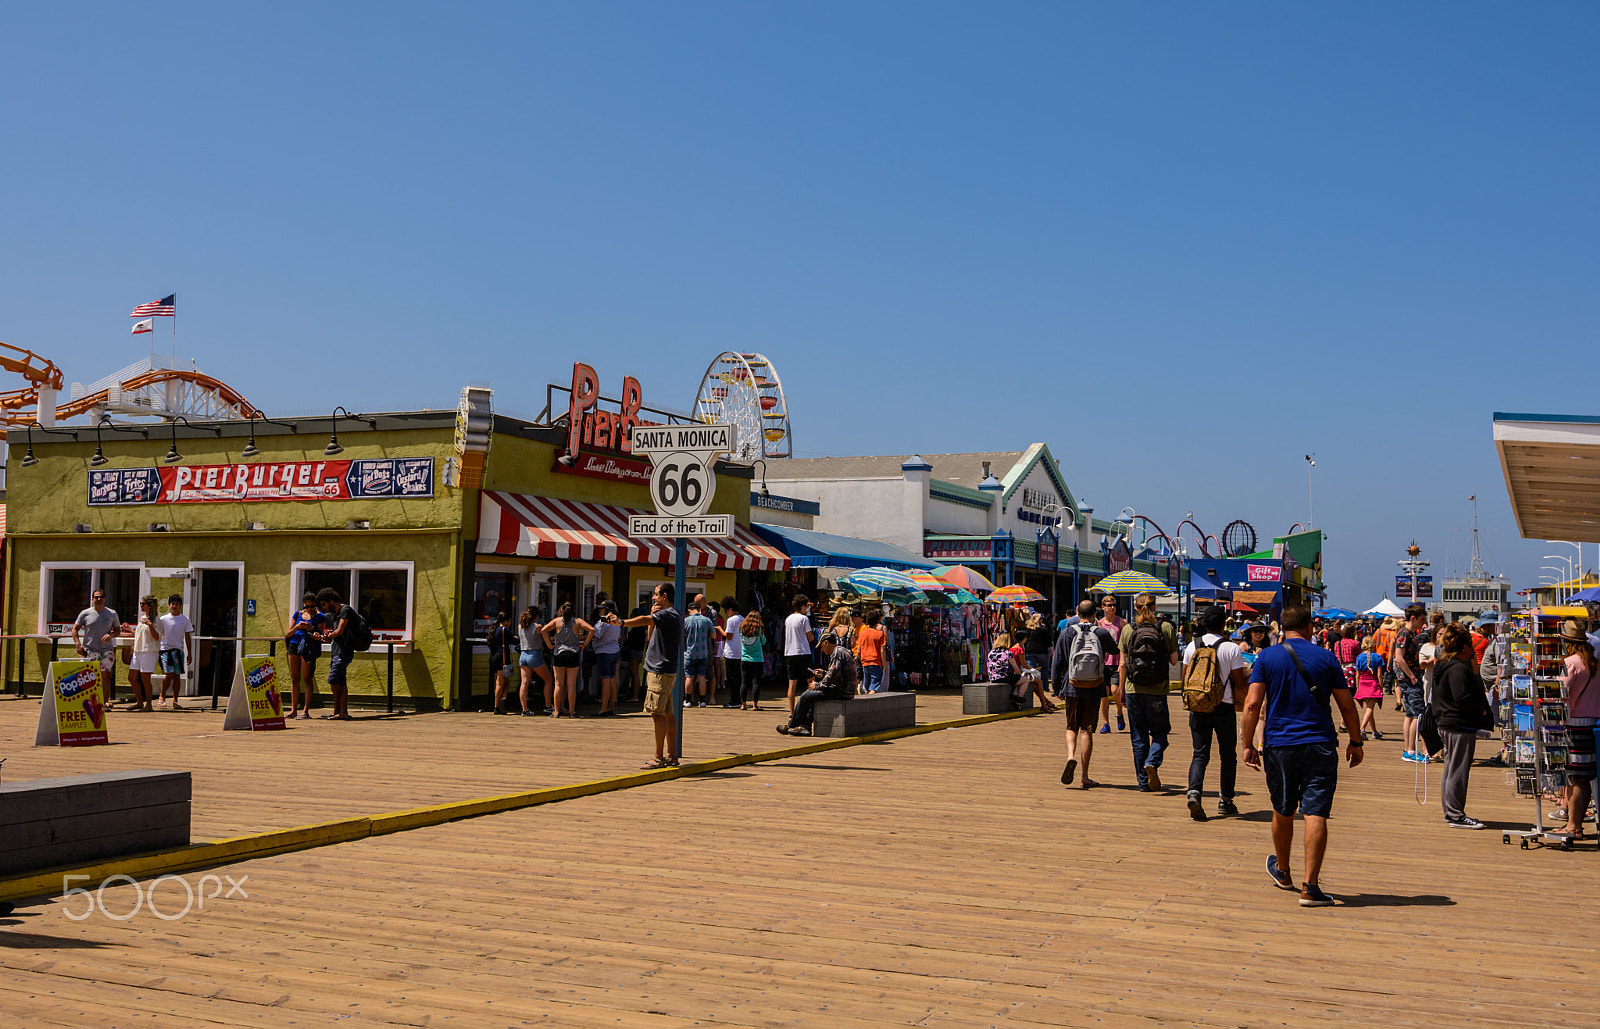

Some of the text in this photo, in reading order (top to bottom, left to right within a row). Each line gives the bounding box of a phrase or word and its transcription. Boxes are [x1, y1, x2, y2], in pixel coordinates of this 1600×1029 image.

[635, 430, 727, 448] SANTA MONICA
[374, 469, 390, 481] Dogs
[397, 470, 421, 486] Custard
[91, 481, 118, 498] Burgers
[124, 478, 146, 493] Fries
[324, 484, 338, 494] 66
[403, 482, 427, 494] Shakes
[658, 463, 702, 506] 66
[757, 496, 794, 511] BEACHCOMBER
[633, 519, 724, 533] End of the Trail
[930, 541, 986, 551] PLAYLAND
[1255, 567, 1271, 575] Gift
[59, 671, 97, 694] Popsicle
[248, 665, 274, 686] Popsicle
[250, 700, 270, 710] FREE
[60, 711, 87, 722] FREE
[60, 721, 87, 729] SAMPLES
